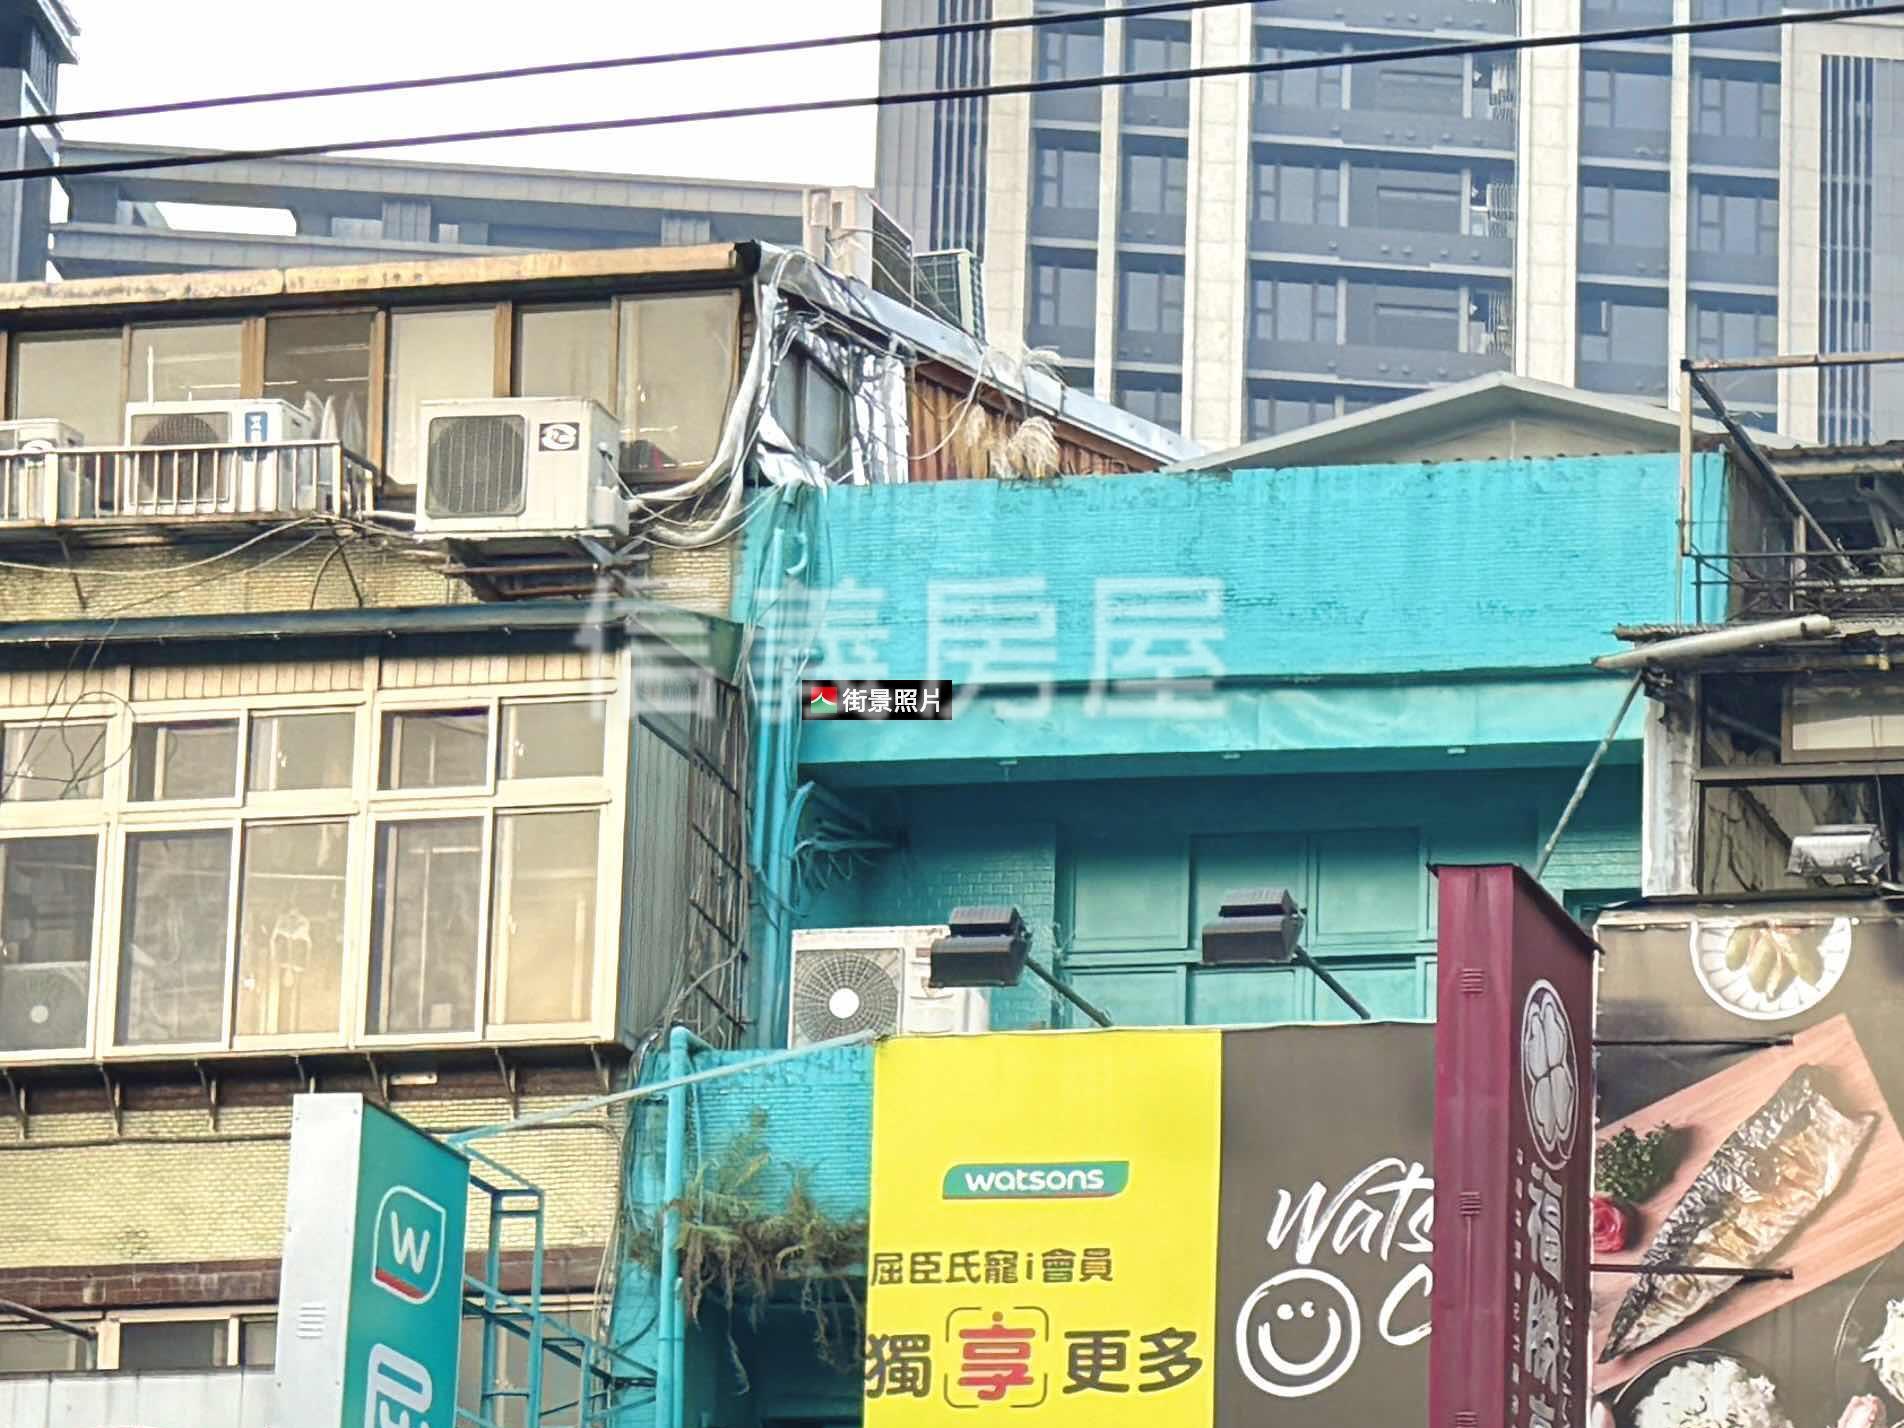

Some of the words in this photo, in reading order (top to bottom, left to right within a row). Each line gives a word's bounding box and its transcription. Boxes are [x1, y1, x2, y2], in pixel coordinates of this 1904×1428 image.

[963, 1166, 1105, 1194] watsons
[870, 1249, 1113, 1285] 屈臣氏寵i會員
